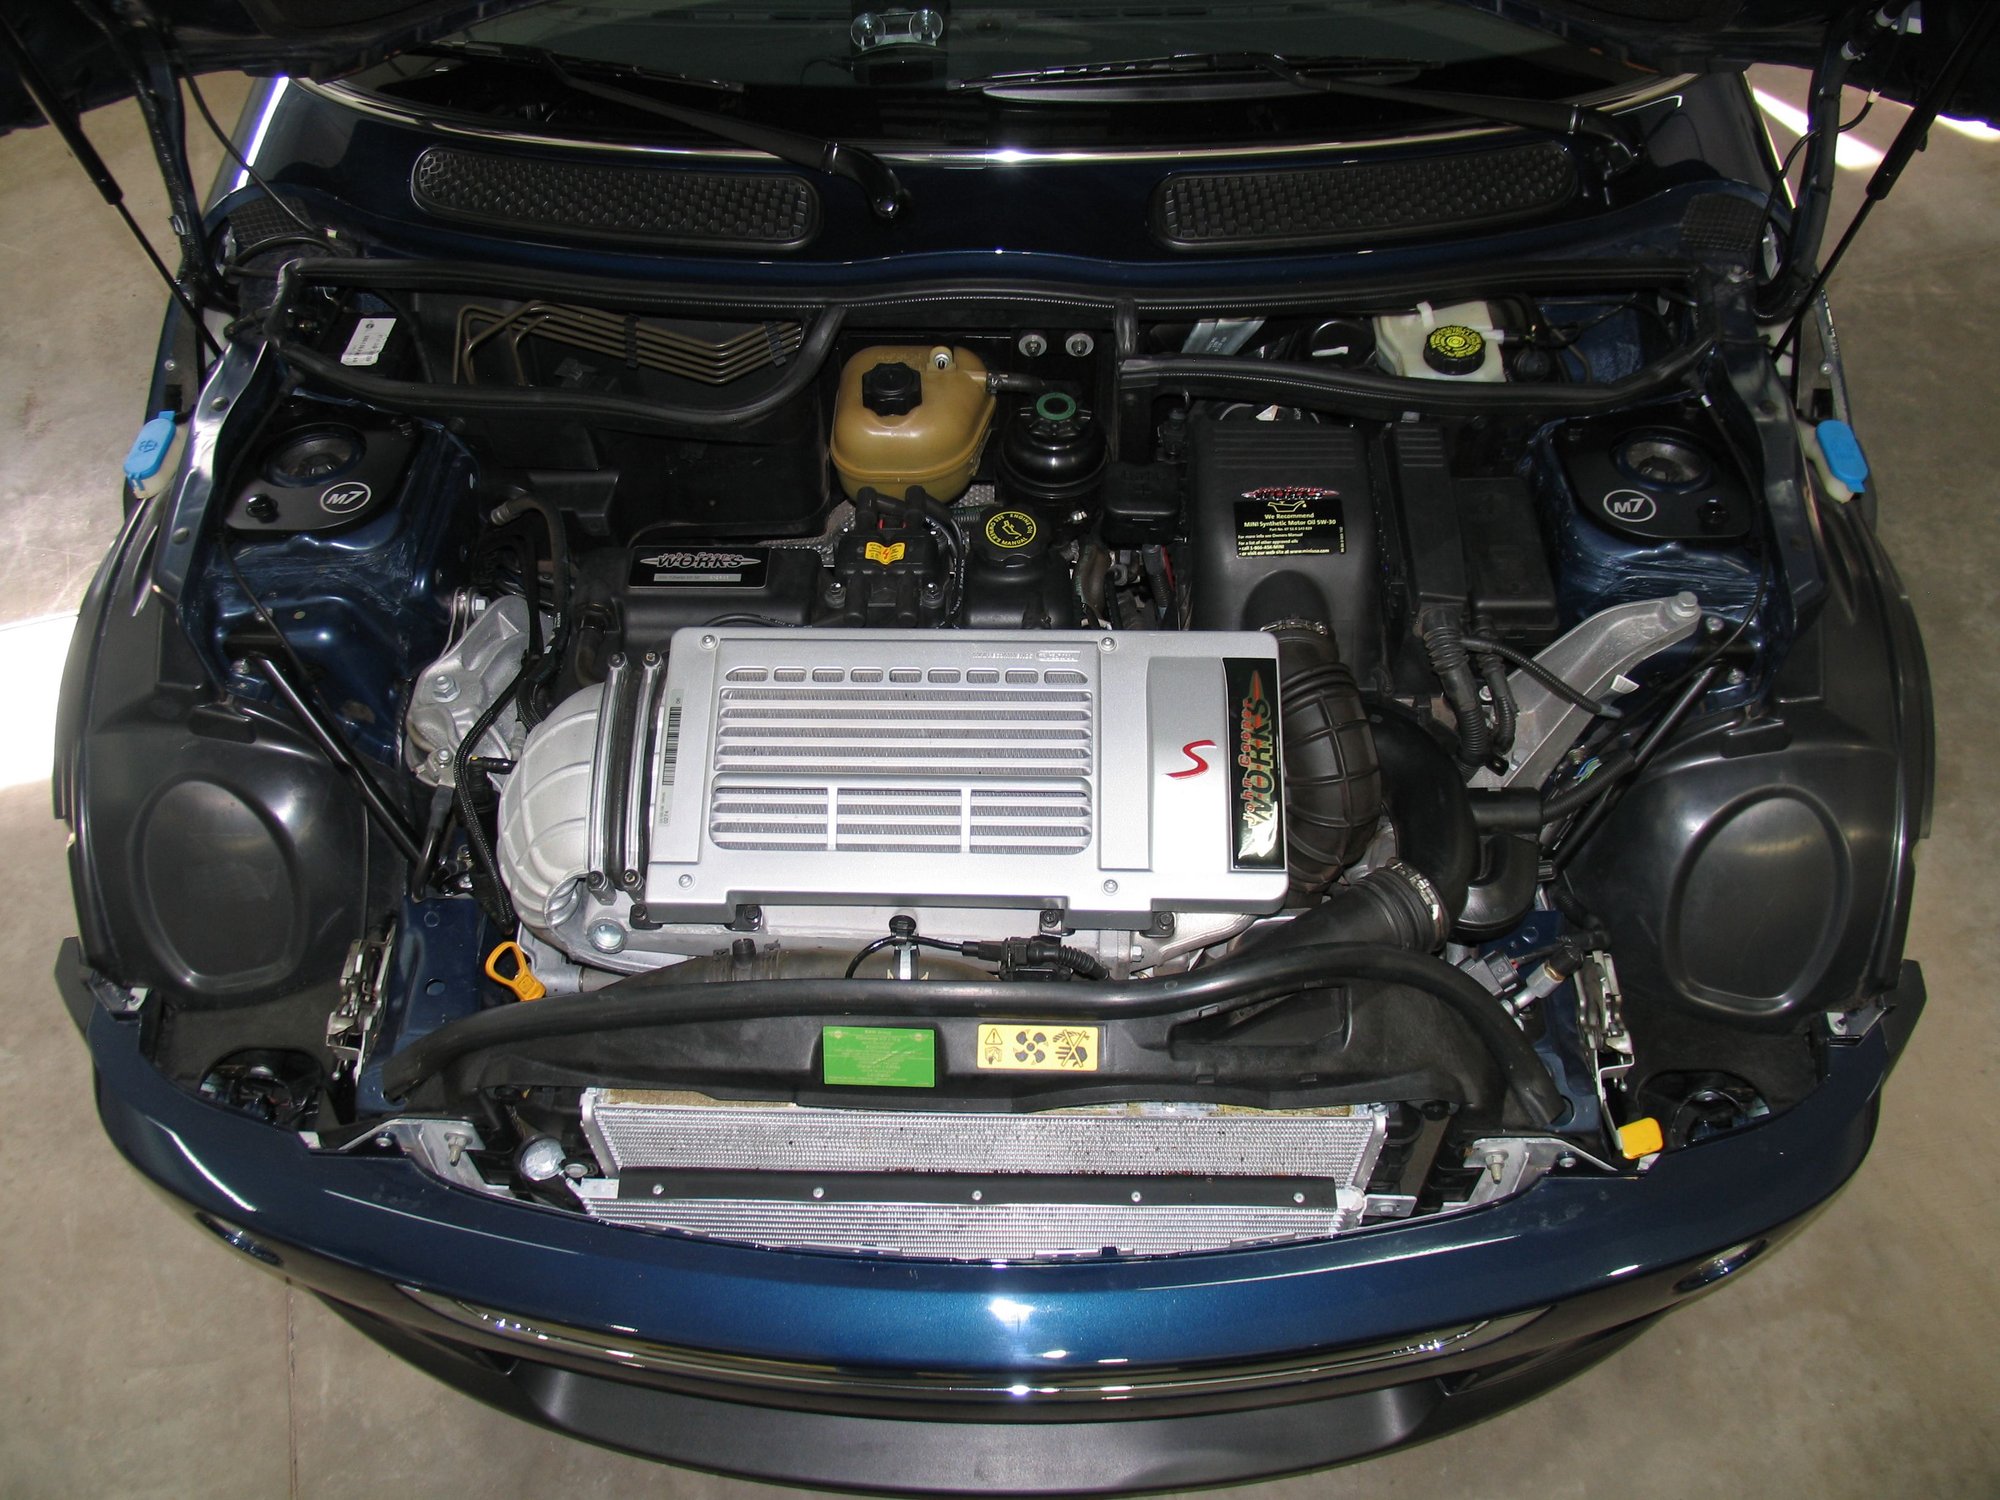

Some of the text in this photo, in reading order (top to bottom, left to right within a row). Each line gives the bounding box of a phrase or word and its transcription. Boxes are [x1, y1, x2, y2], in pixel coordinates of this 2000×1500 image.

[326, 490, 366, 505] M7
[1614, 498, 1645, 513] M7
[1010, 514, 1031, 525] ENGINE
[1260, 520, 1287, 529] Synthetic
[657, 554, 743, 568] WORKS
[1238, 697, 1254, 767] Cooper
[1165, 739, 1217, 780] S
[1247, 697, 1275, 823] WORKS
